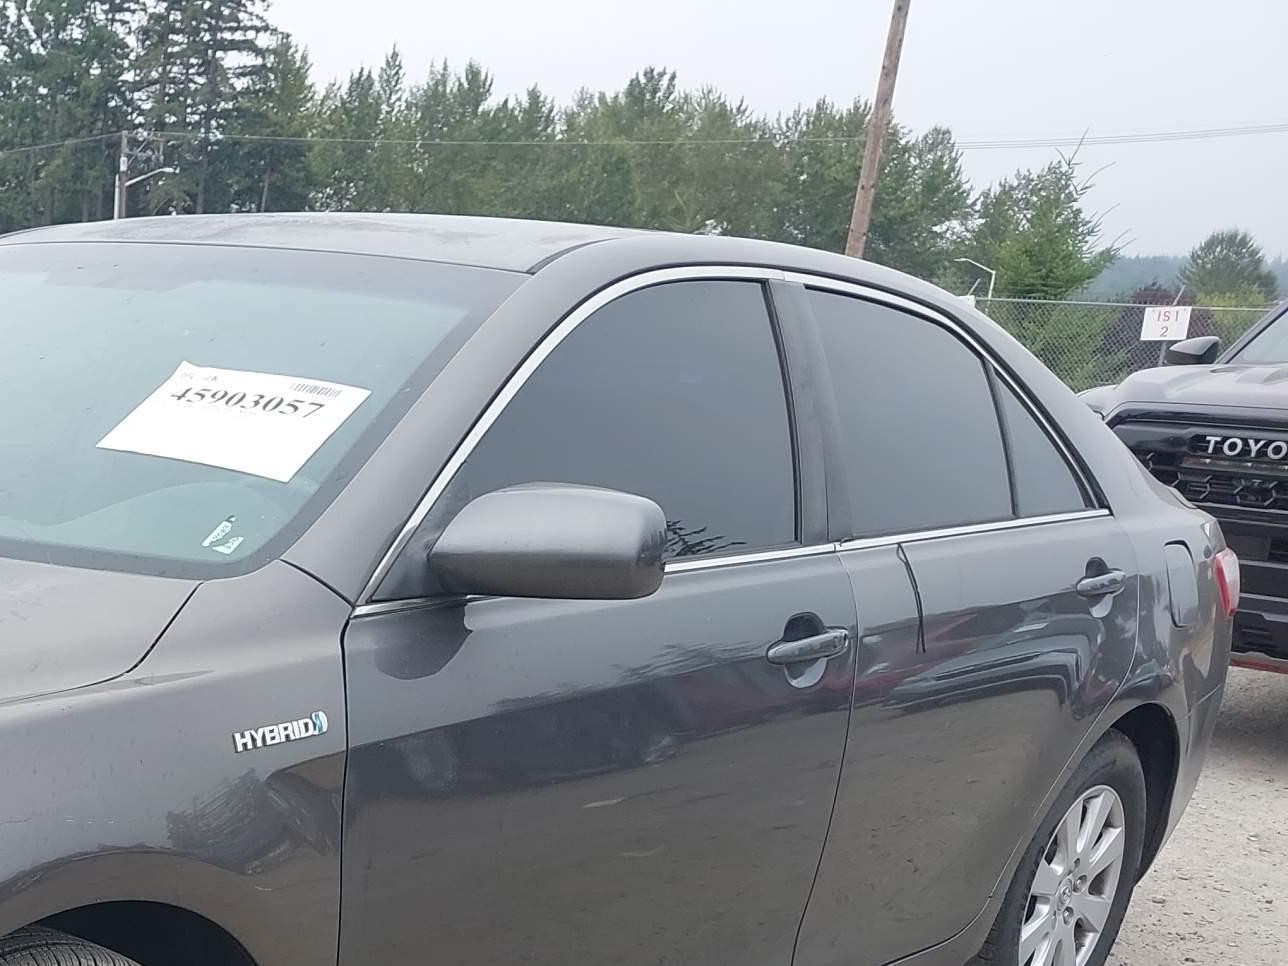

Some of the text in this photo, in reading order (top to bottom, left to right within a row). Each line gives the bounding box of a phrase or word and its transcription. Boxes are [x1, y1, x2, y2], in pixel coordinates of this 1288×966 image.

[1159, 325, 1169, 337] 2
[170, 386, 325, 418] 45903057
[1205, 435, 1288, 460] TOYO
[233, 718, 316, 752] HYBRID
